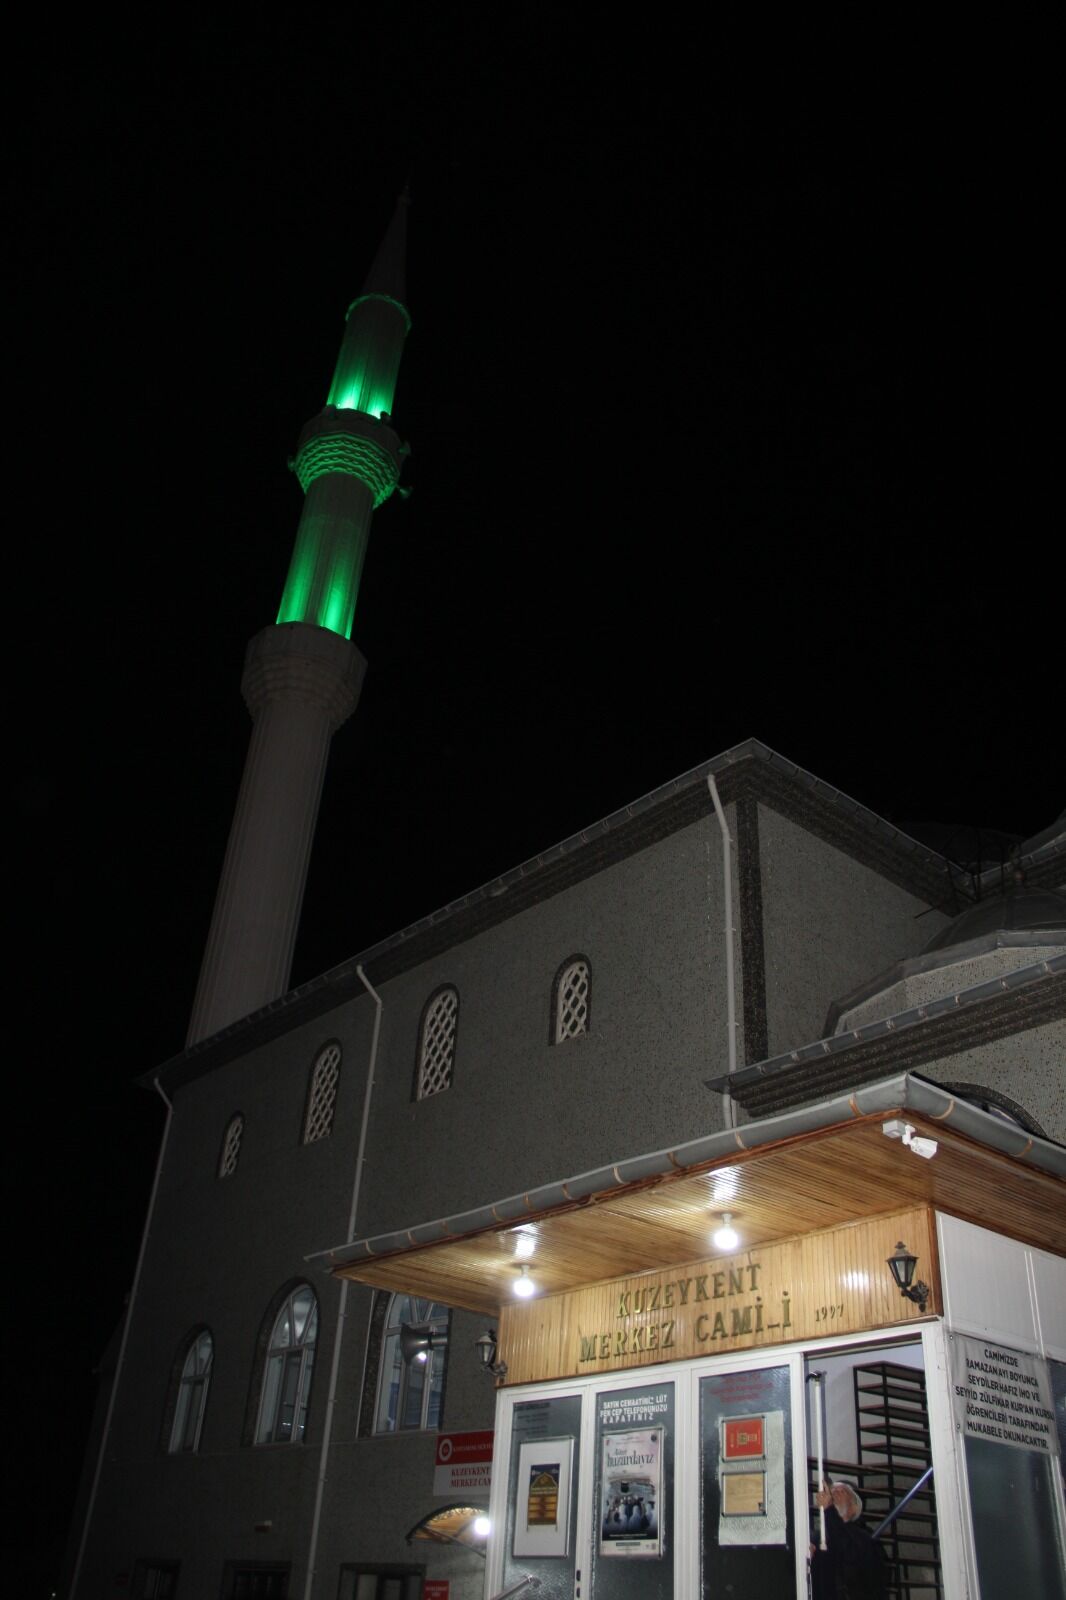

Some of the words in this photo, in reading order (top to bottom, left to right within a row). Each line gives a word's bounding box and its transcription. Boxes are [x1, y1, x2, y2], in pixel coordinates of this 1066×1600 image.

[616, 1264, 761, 1318] KUZEYKENT
[815, 1303, 845, 1323] 1997
[579, 1319, 675, 1363] MERKEZ
[985, 1349, 1018, 1367] CAMİMİZDE
[968, 1375, 999, 1391] SEYDİLER
[999, 1382, 1018, 1397] HAFIZ
[1031, 1391, 1041, 1402] VE
[1010, 1372, 1039, 1387] BOYUNCA
[603, 1413, 653, 1424] KAPATINIZ
[1009, 1416, 1050, 1434] TARAFINDAN
[968, 1422, 1002, 1438] MUKABELE
